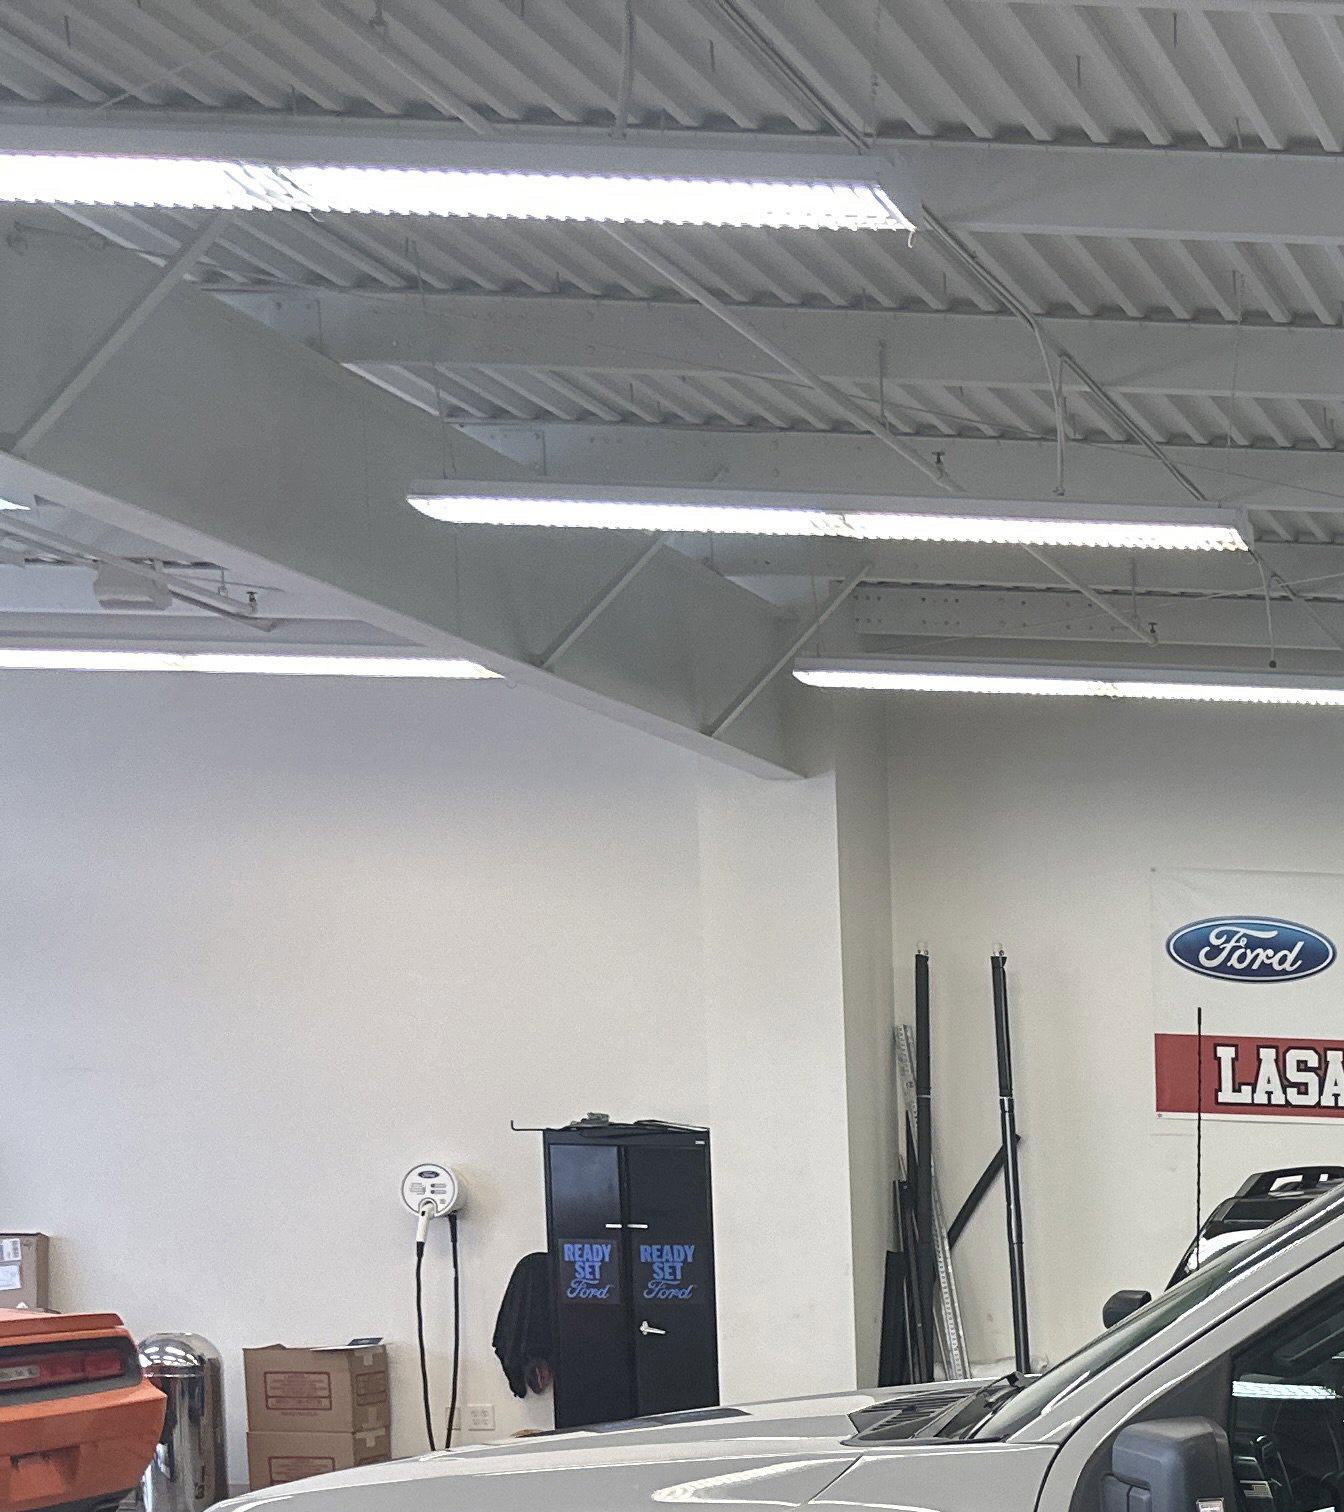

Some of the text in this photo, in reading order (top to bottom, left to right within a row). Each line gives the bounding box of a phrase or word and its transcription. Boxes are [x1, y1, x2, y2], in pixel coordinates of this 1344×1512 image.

[1198, 926, 1305, 972] Ford
[563, 1243, 612, 1262] READY
[639, 1244, 695, 1262] READY
[574, 1262, 602, 1279] SET
[652, 1262, 684, 1280] SET
[566, 1278, 610, 1299] Ford
[643, 1279, 694, 1299] Ford
